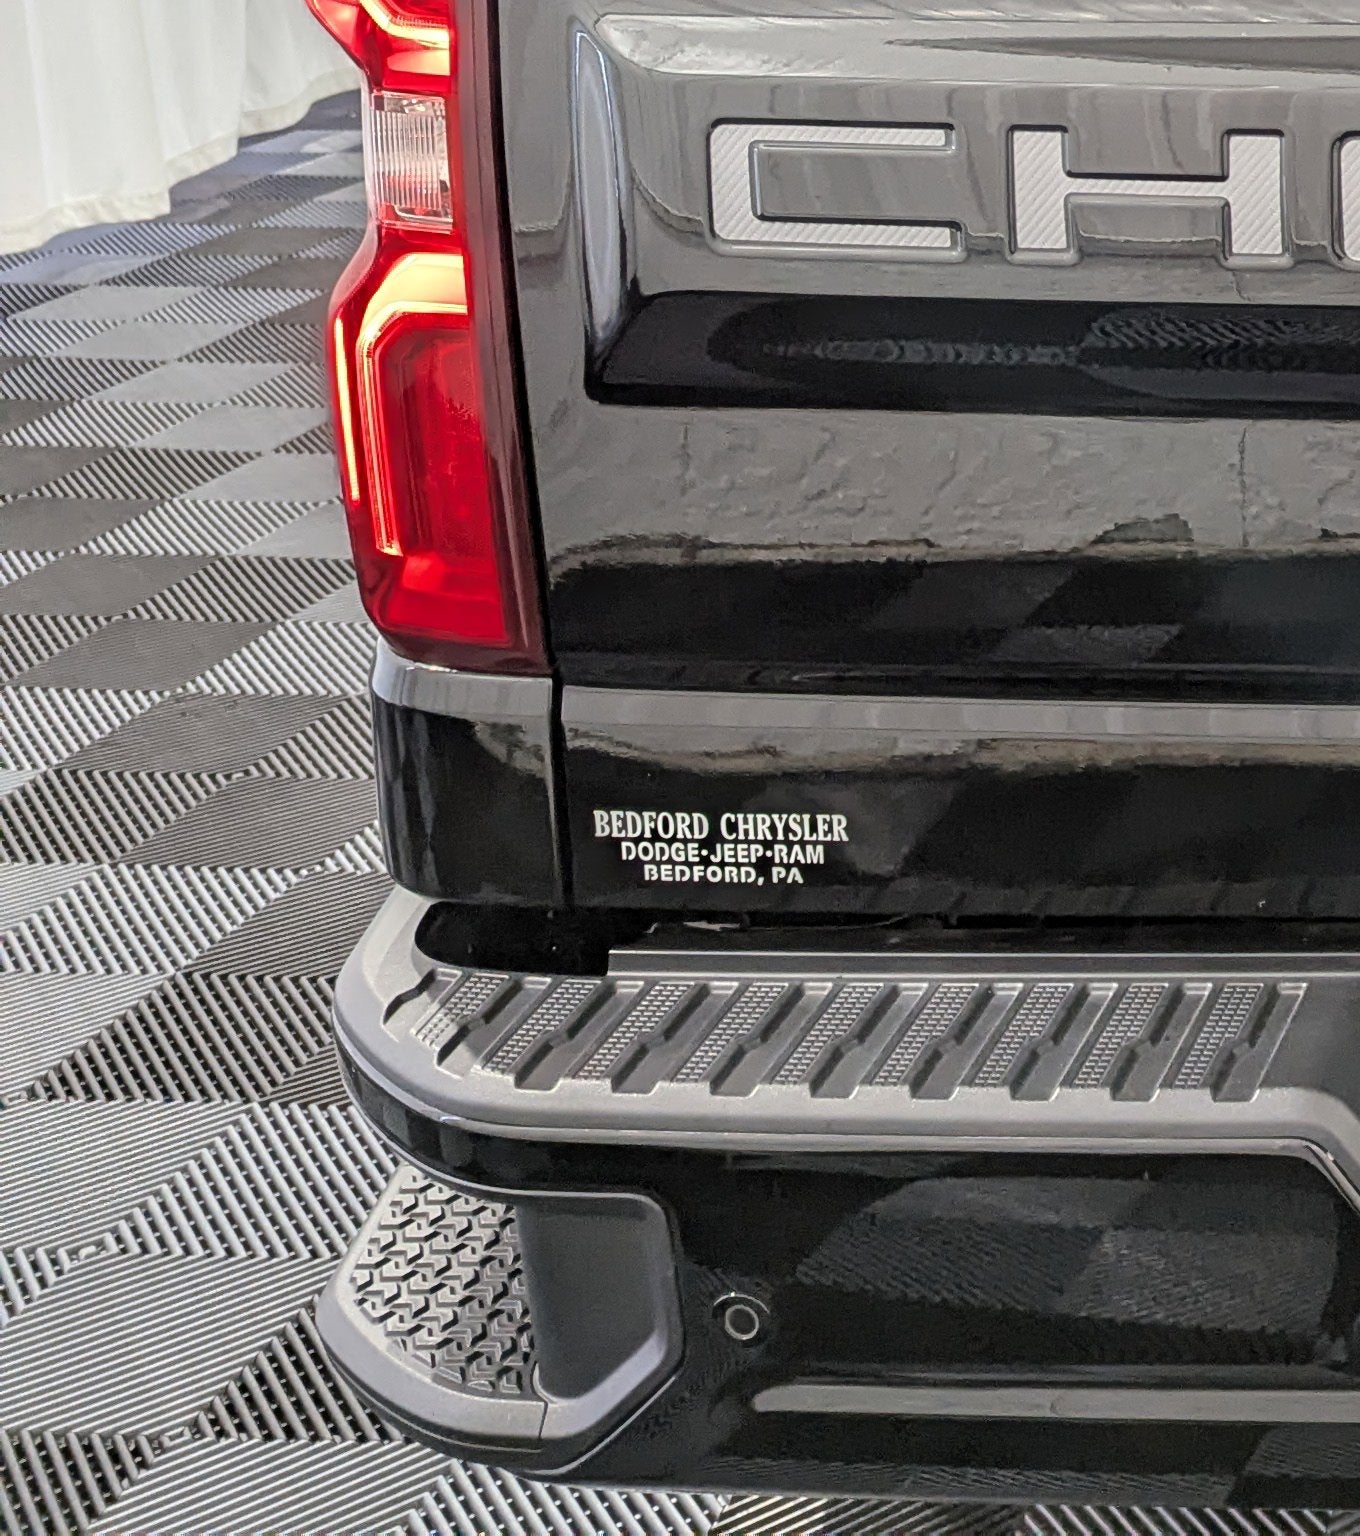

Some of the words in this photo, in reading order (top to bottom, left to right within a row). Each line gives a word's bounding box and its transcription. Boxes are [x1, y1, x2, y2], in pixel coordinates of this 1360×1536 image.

[593, 810, 709, 840] BEDFORD
[720, 813, 849, 842] CHRYSLER
[643, 865, 765, 886] BEDFORD,
[771, 866, 804, 884] PA
